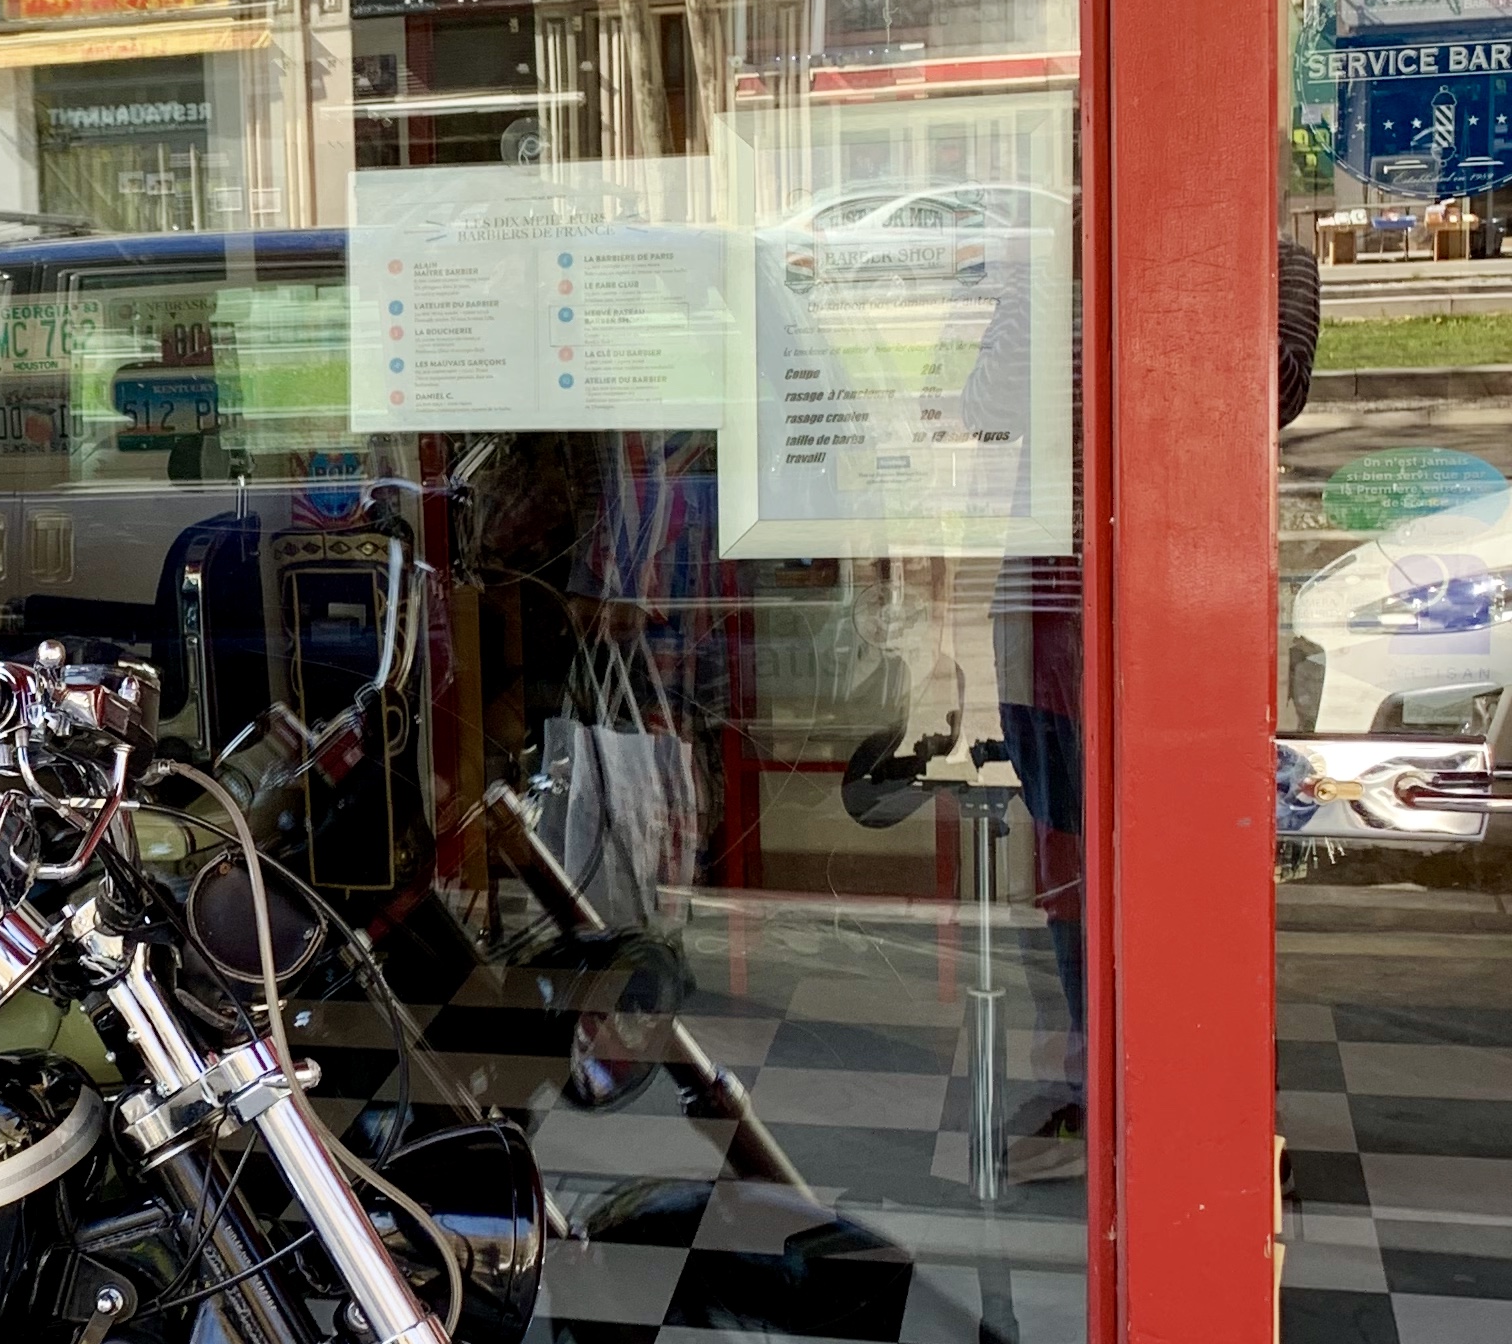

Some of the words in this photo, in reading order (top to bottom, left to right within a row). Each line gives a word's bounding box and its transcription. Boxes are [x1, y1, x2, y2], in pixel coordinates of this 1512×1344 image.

[1308, 47, 1439, 80] SERVICE
[494, 216, 521, 229] DIX
[457, 227, 531, 242] BARBIERS
[533, 226, 552, 240] DE
[555, 225, 616, 239] FRANCE
[898, 246, 946, 264] SHOP
[0, 306, 72, 320] GEORGIA
[13, 361, 59, 372] HOUSTON
[153, 383, 217, 395] KENTUCKY
[784, 390, 824, 403] rasage
[122, 400, 176, 431] 512
[785, 413, 825, 426] rasage
[1363, 457, 1381, 467] On
[1384, 457, 1418, 467] n'est
[1421, 455, 1470, 468] jamais
[1362, 470, 1393, 481] bien
[1396, 470, 1429, 481] servi
[1433, 470, 1459, 483] que
[1462, 470, 1487, 483] par
[1389, 667, 1491, 681] ARTISAN
